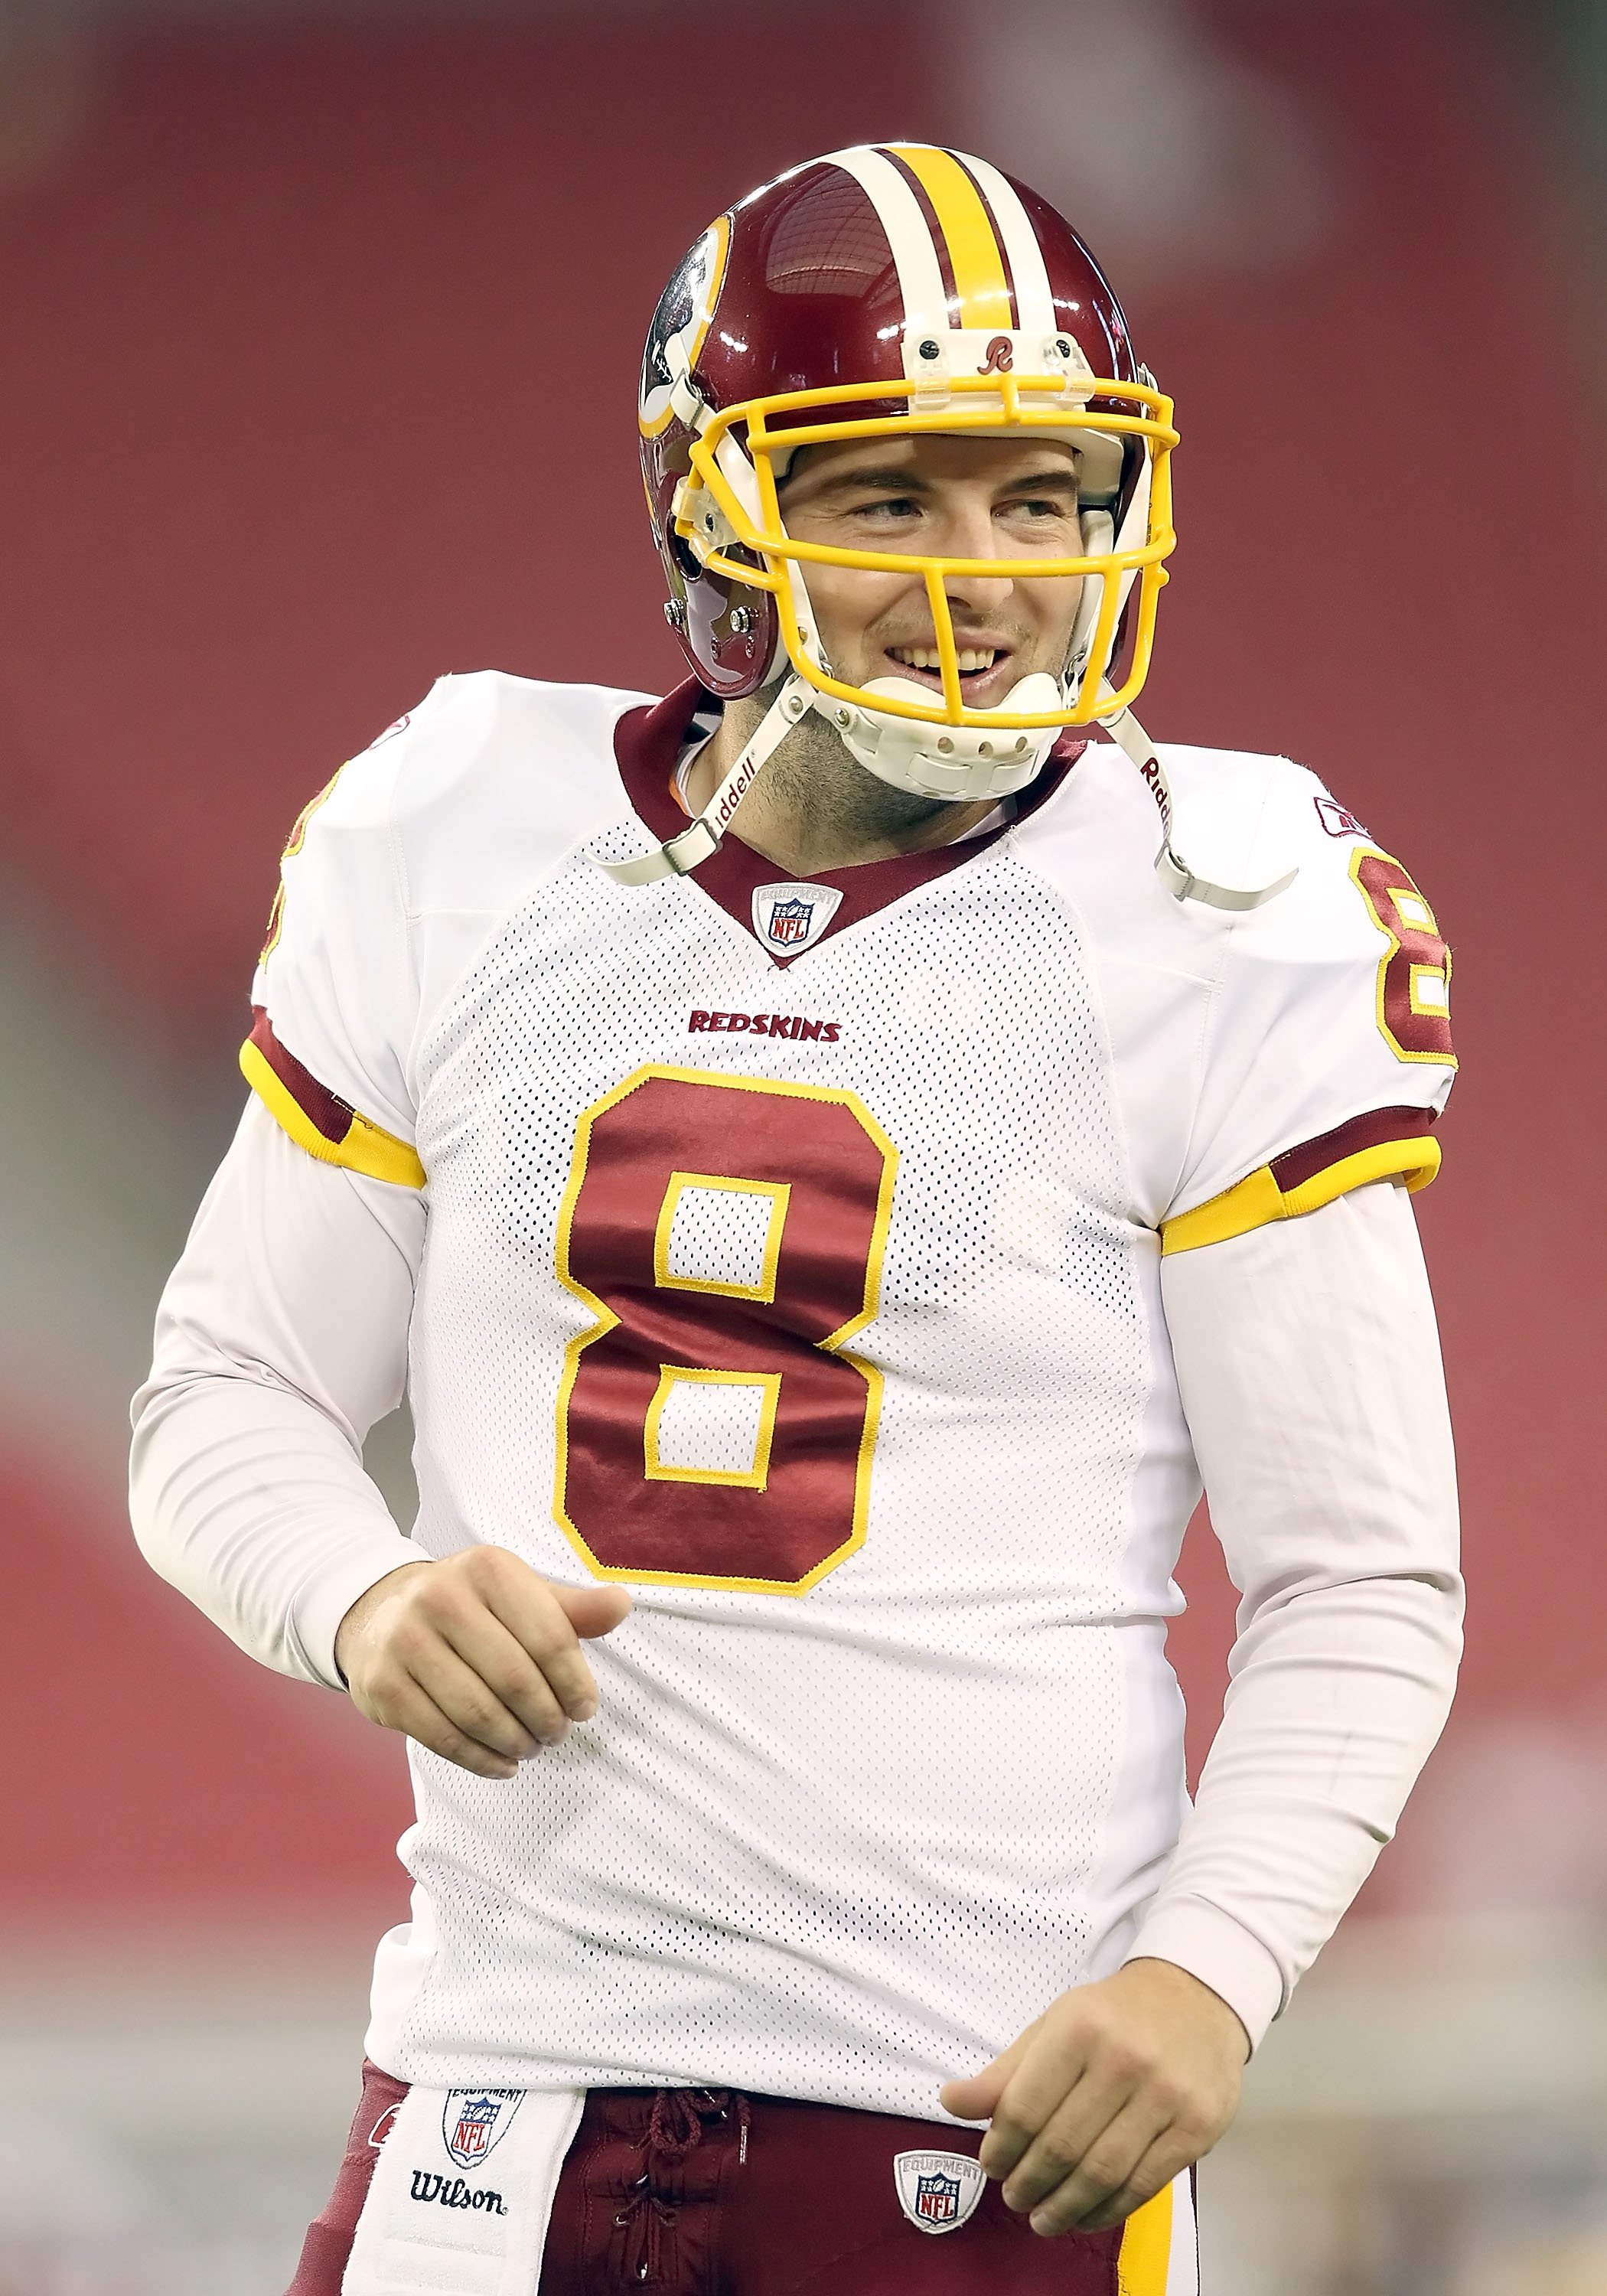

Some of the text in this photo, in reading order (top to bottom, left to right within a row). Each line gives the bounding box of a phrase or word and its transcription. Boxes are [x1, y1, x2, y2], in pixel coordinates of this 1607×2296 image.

[715, 757, 755, 828] iddell
[773, 918, 804, 941] NFL
[1348, 847, 1459, 1072] 8
[689, 1010, 842, 1042] REDSKINS
[553, 1063, 901, 1597] 8
[453, 2122, 485, 2153] NFL
[903, 2158, 979, 2180] EQUIPMENT
[411, 2170, 504, 2215] Wilson
[921, 2193, 953, 2219] NFL
